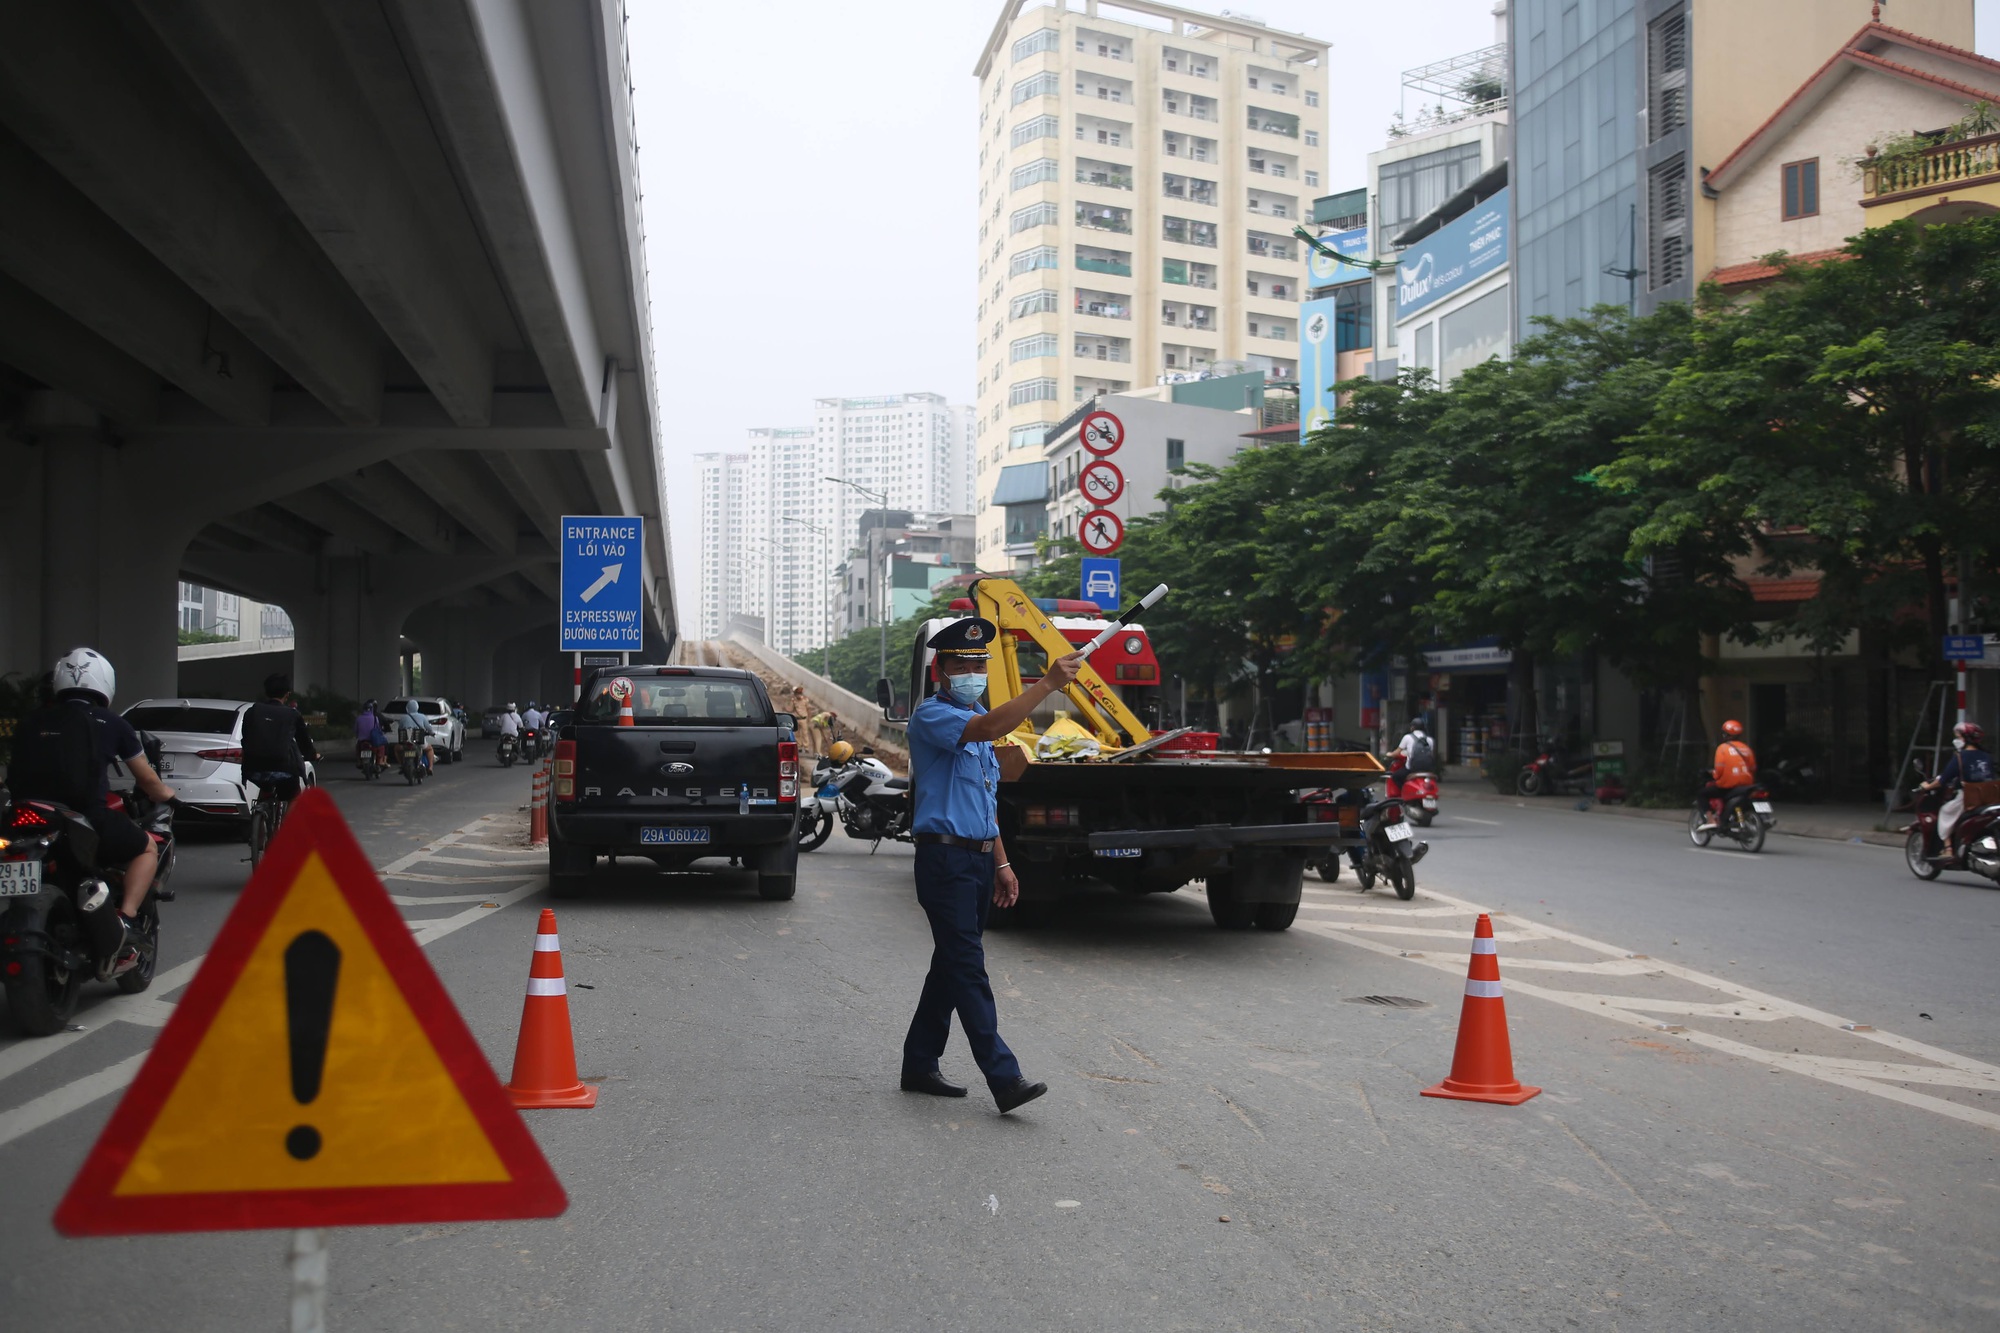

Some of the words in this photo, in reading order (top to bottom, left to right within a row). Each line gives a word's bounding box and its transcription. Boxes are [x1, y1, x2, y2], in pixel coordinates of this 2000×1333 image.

[1400, 278, 1429, 306] Dulux
[568, 527, 635, 539] ENTRANCE
[578, 539, 598, 556] LỐI
[602, 541, 625, 557] VÀO
[566, 610, 637, 623] EXPRESSWAY
[564, 623, 598, 640] ĐƯỜNG
[599, 628, 619, 640] CAO
[621, 623, 640, 640] TỐC
[585, 786, 769, 797] RANGER
[643, 828, 708, 843] 29A-060.22
[0, 862, 32, 879] 29-A1
